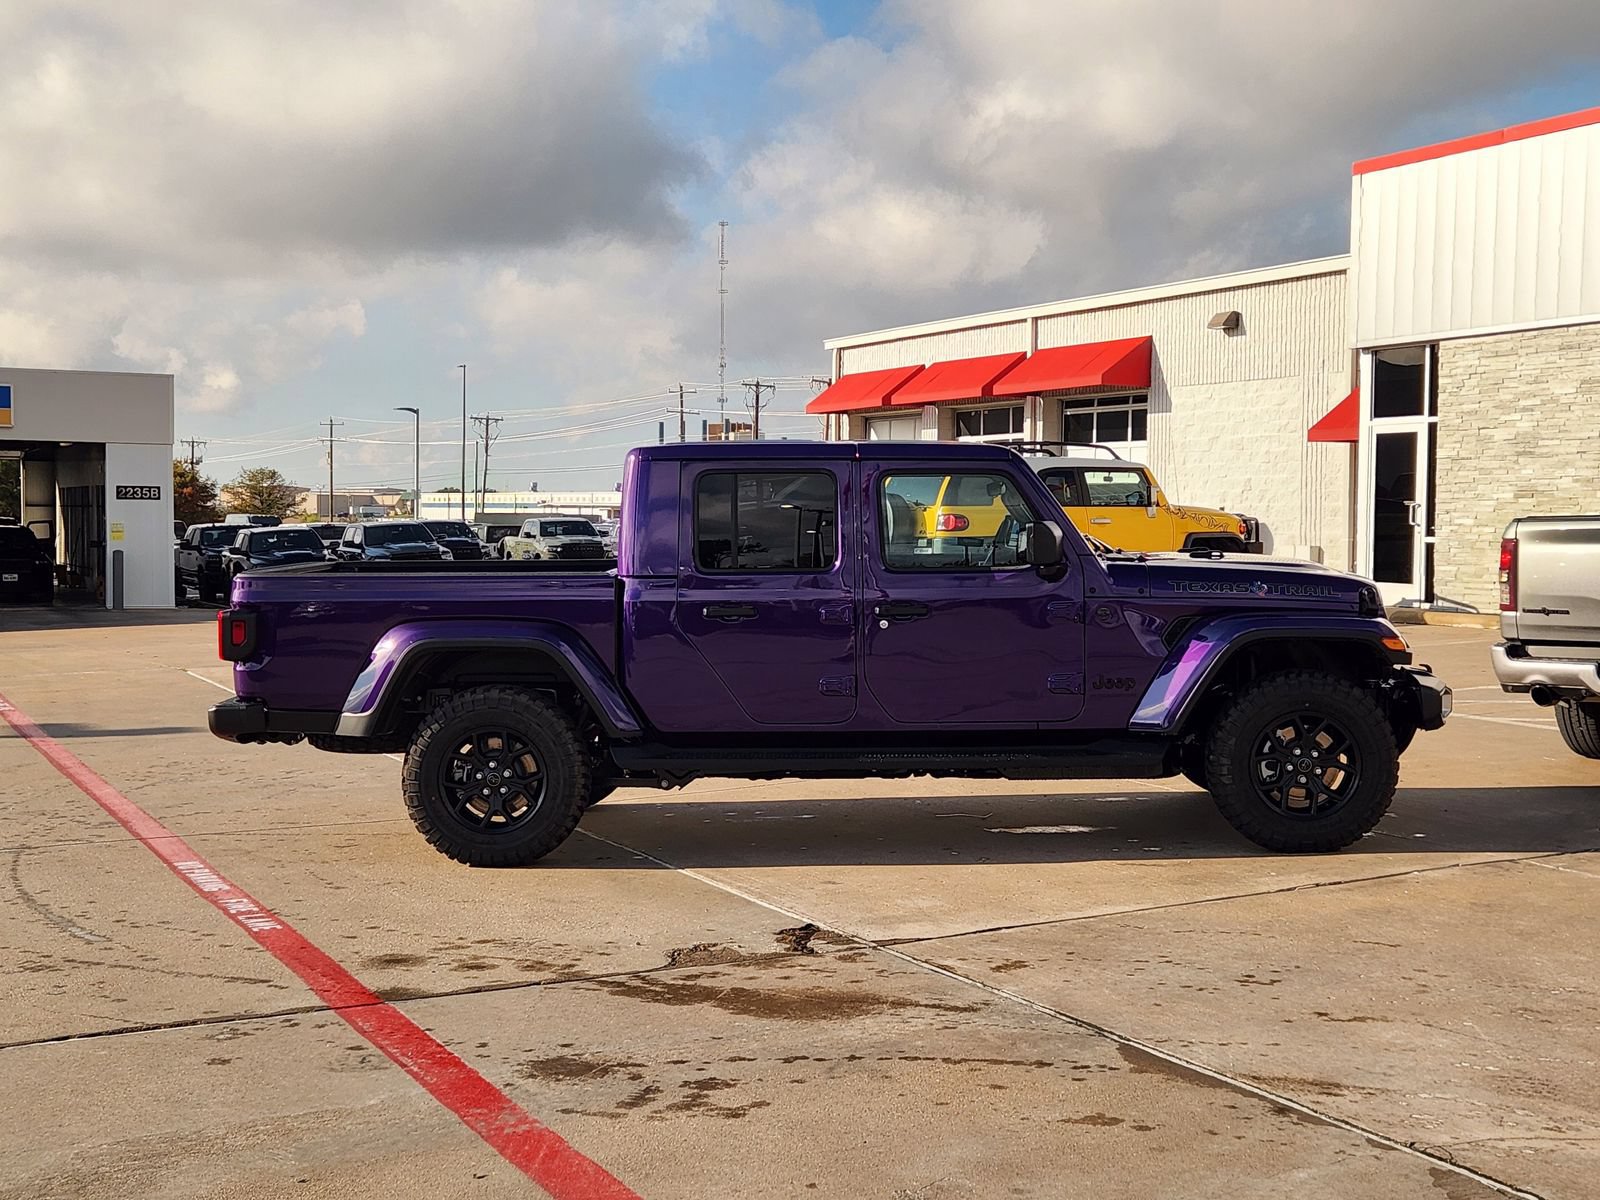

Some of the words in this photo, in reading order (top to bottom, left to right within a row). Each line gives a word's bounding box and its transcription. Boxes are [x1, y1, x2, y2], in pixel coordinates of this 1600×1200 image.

[117, 487, 160, 499] 2235B
[1168, 580, 1251, 593] TEXAS
[1267, 583, 1342, 598] TRAIL
[1092, 673, 1136, 691] Jeep
[237, 913, 283, 932] LANE
